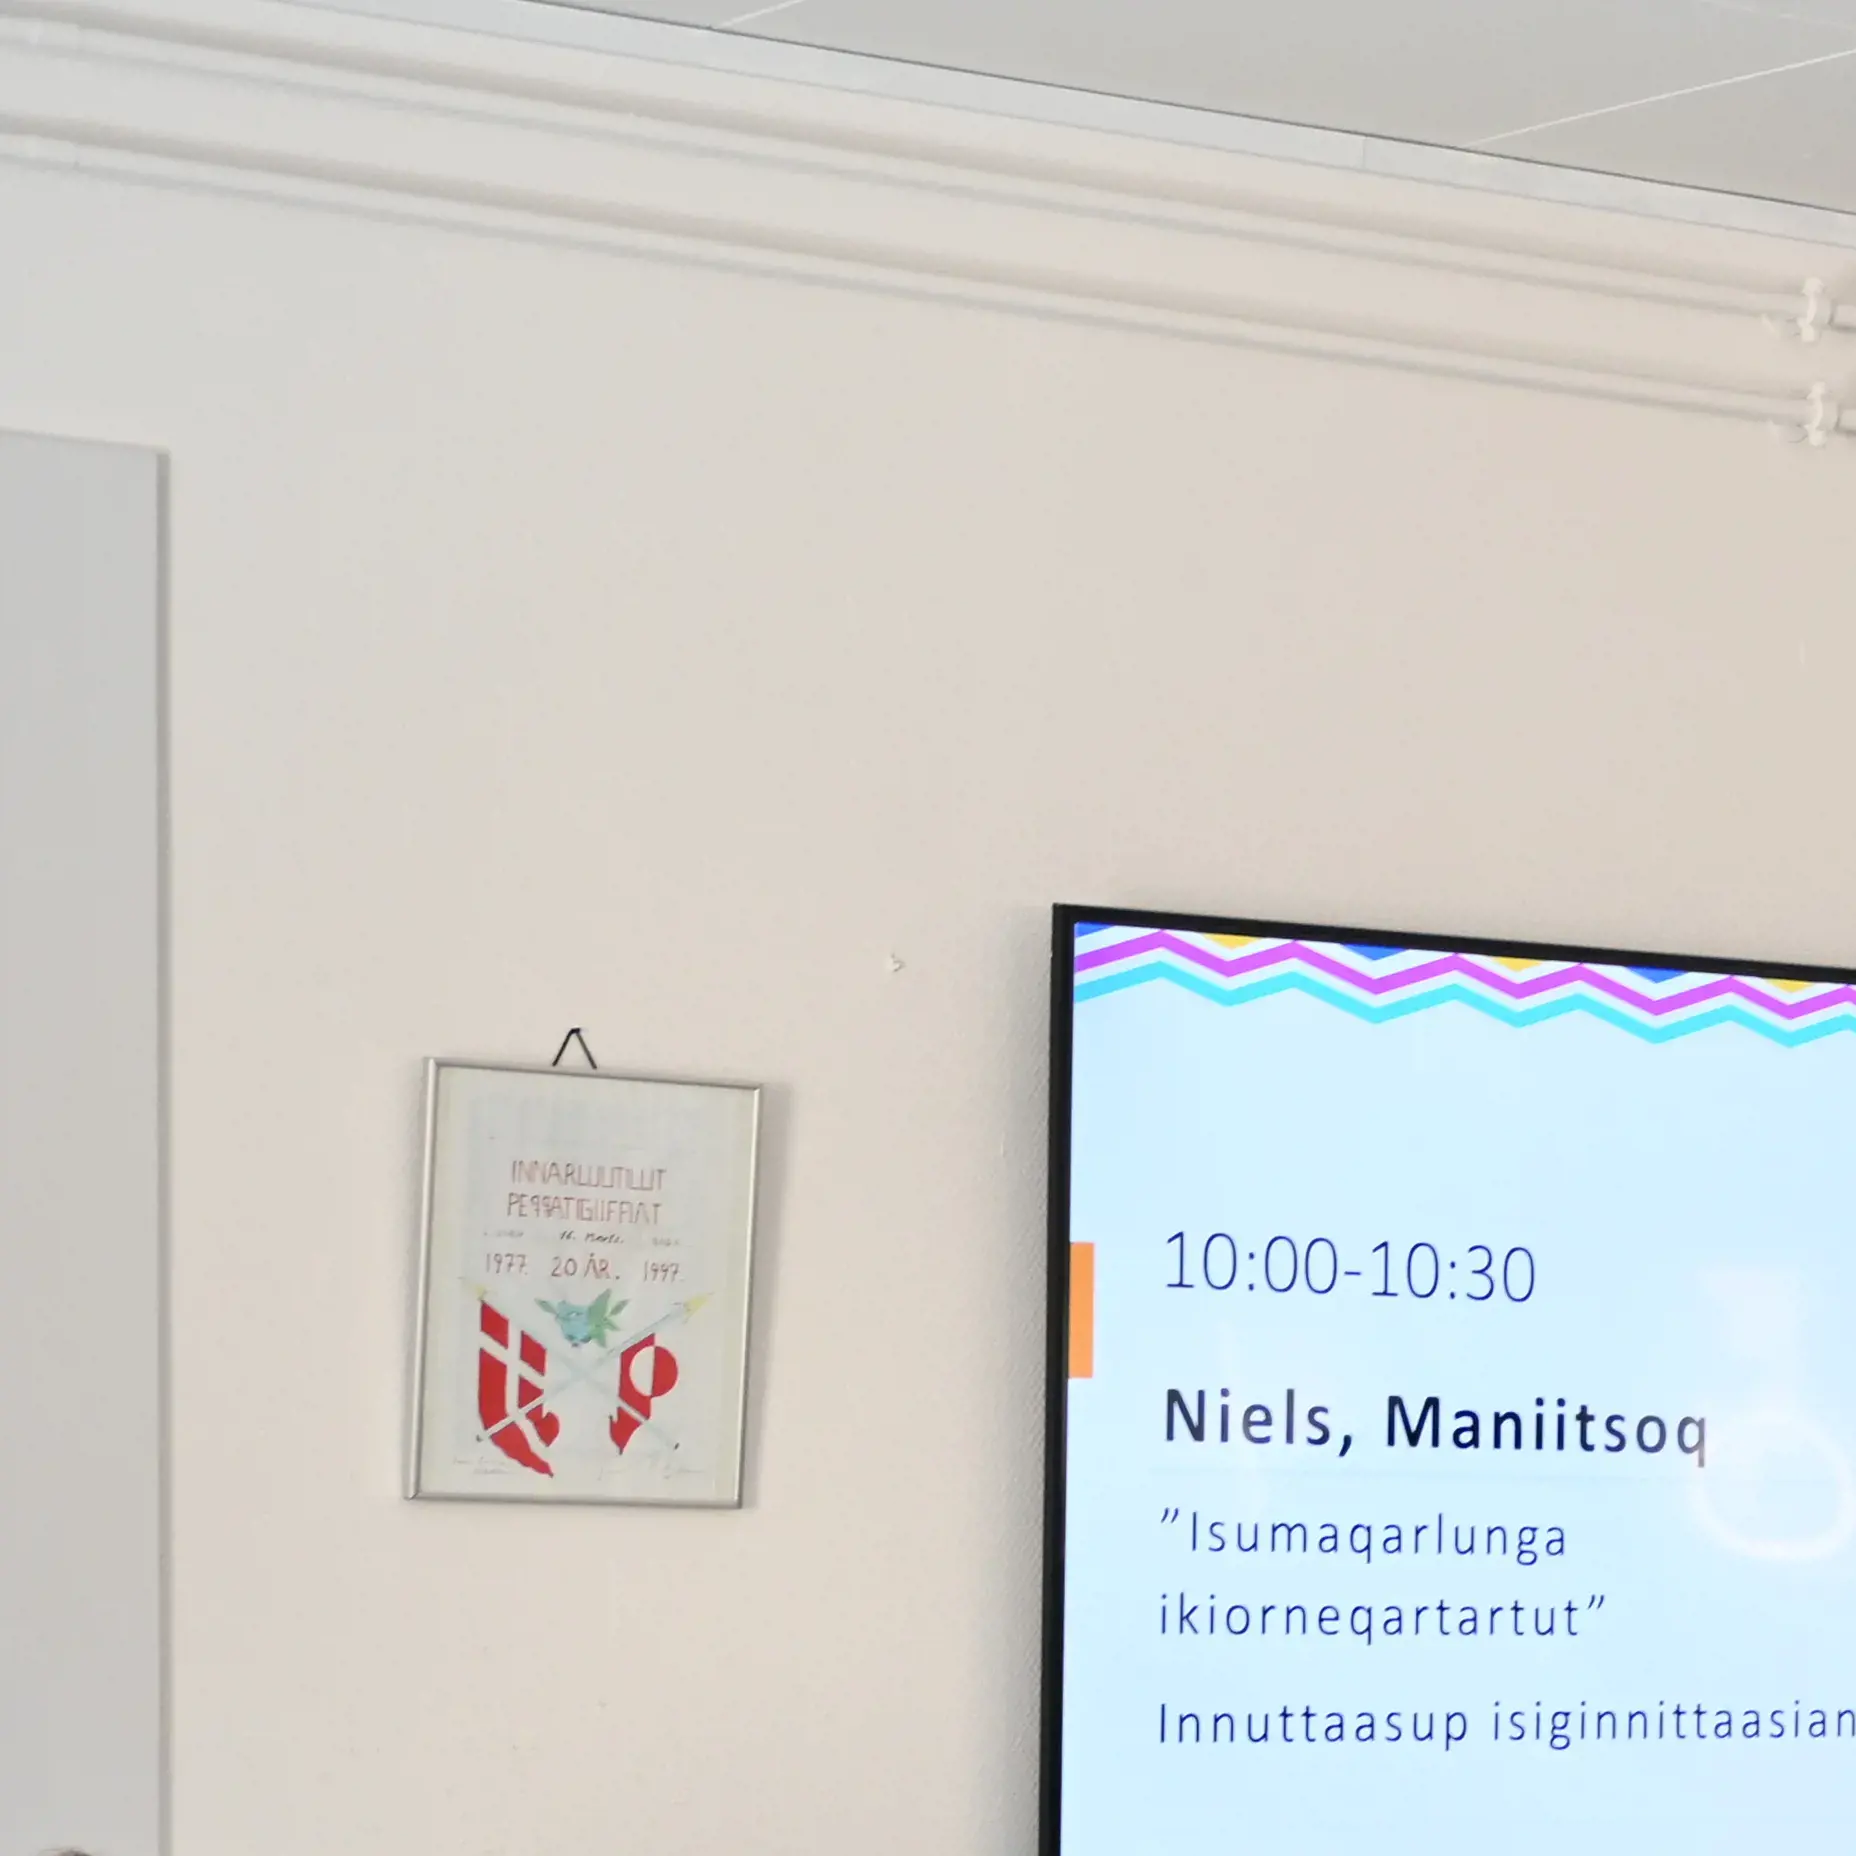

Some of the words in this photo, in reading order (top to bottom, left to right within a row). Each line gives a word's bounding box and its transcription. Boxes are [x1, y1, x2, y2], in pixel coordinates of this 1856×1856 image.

[551, 1256, 577, 1278] 20
[1165, 1229, 1537, 1304] 10:00-10:30
[1165, 1387, 1353, 1458] Niels,
[1386, 1394, 1708, 1468] Maniitsoq
[1158, 1701, 1469, 1752] Innuttaasup
